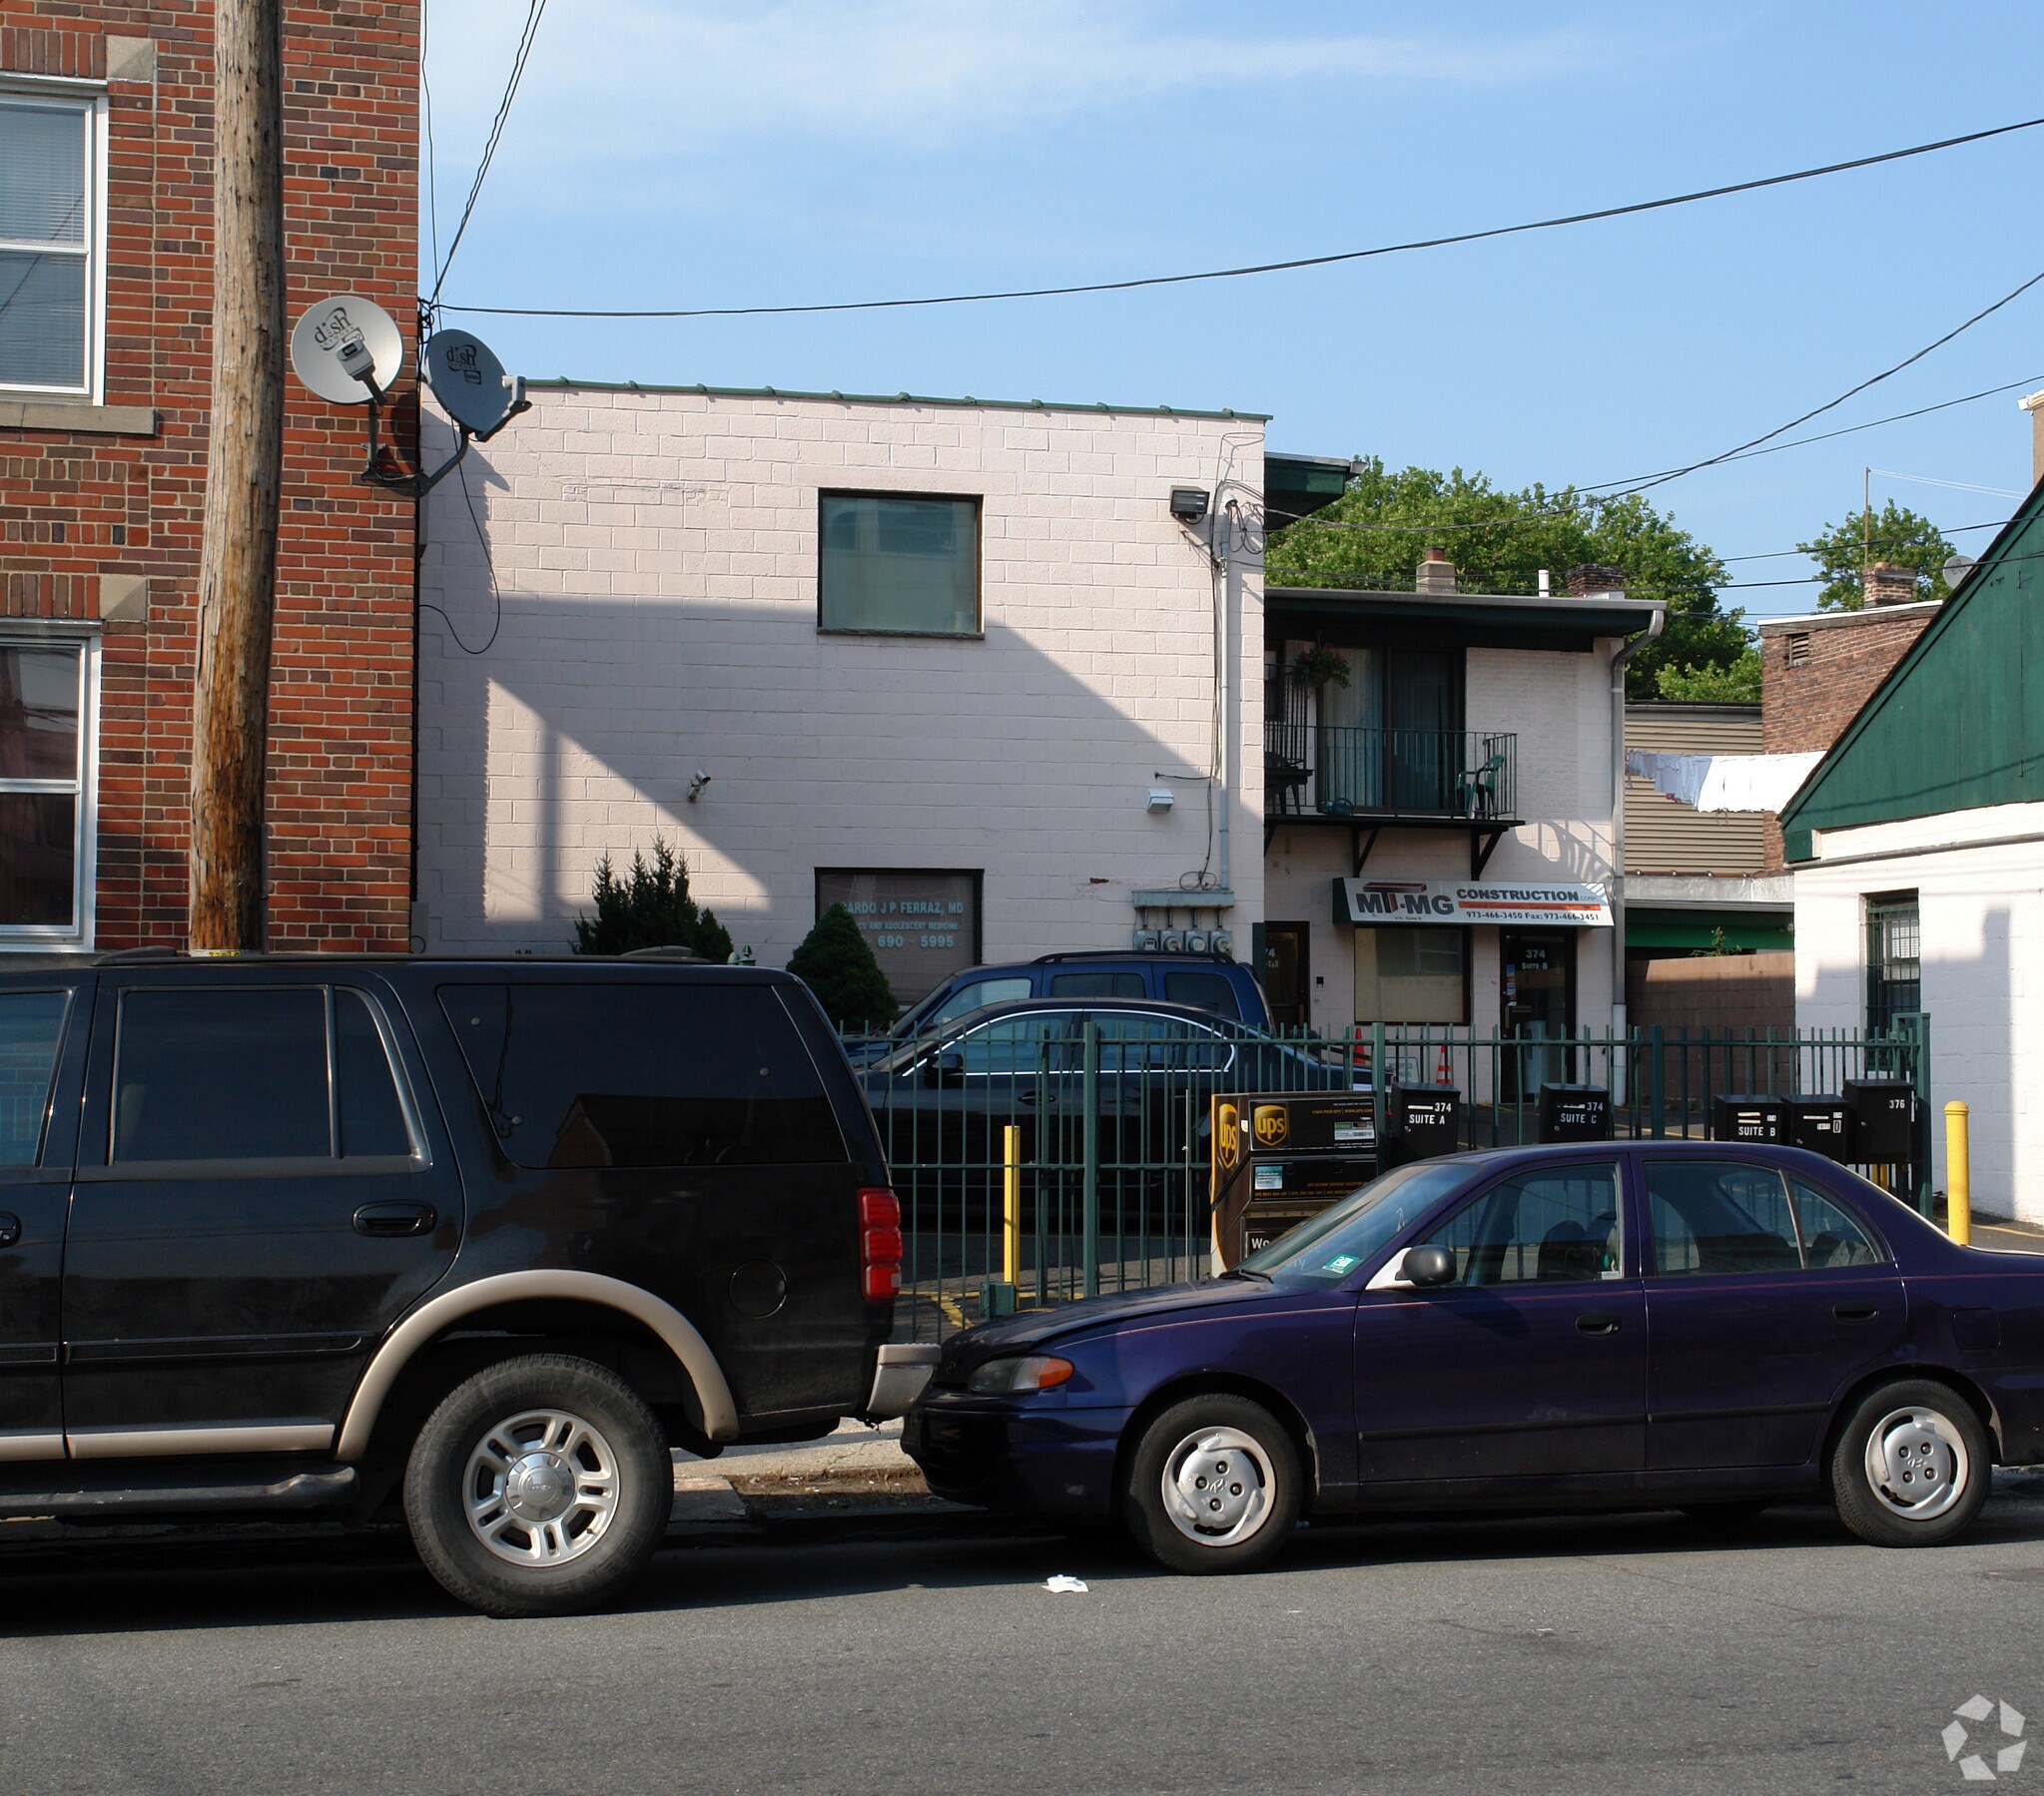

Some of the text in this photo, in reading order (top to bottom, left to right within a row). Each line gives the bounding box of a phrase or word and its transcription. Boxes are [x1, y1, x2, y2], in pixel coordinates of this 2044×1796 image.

[1456, 889, 1579, 901] CONSTRUCTION
[829, 901, 964, 916] ARDO J P FERRAZ, MD
[884, 921, 926, 930] ADOLESCENT
[928, 921, 959, 930] MEDICINE
[877, 935, 904, 948] 690
[920, 935, 954, 948] 5995
[1526, 949, 1546, 959] 374
[1434, 1102, 1452, 1113] 374
[1586, 1102, 1603, 1112] 374
[1889, 1099, 1905, 1109] 376
[1408, 1114, 1445, 1125] SUITE A
[1560, 1113, 1597, 1125] SUITE C
[1258, 1118, 1285, 1140] ups
[1738, 1126, 1776, 1137] SUITE B
[1221, 1125, 1237, 1159] ups
